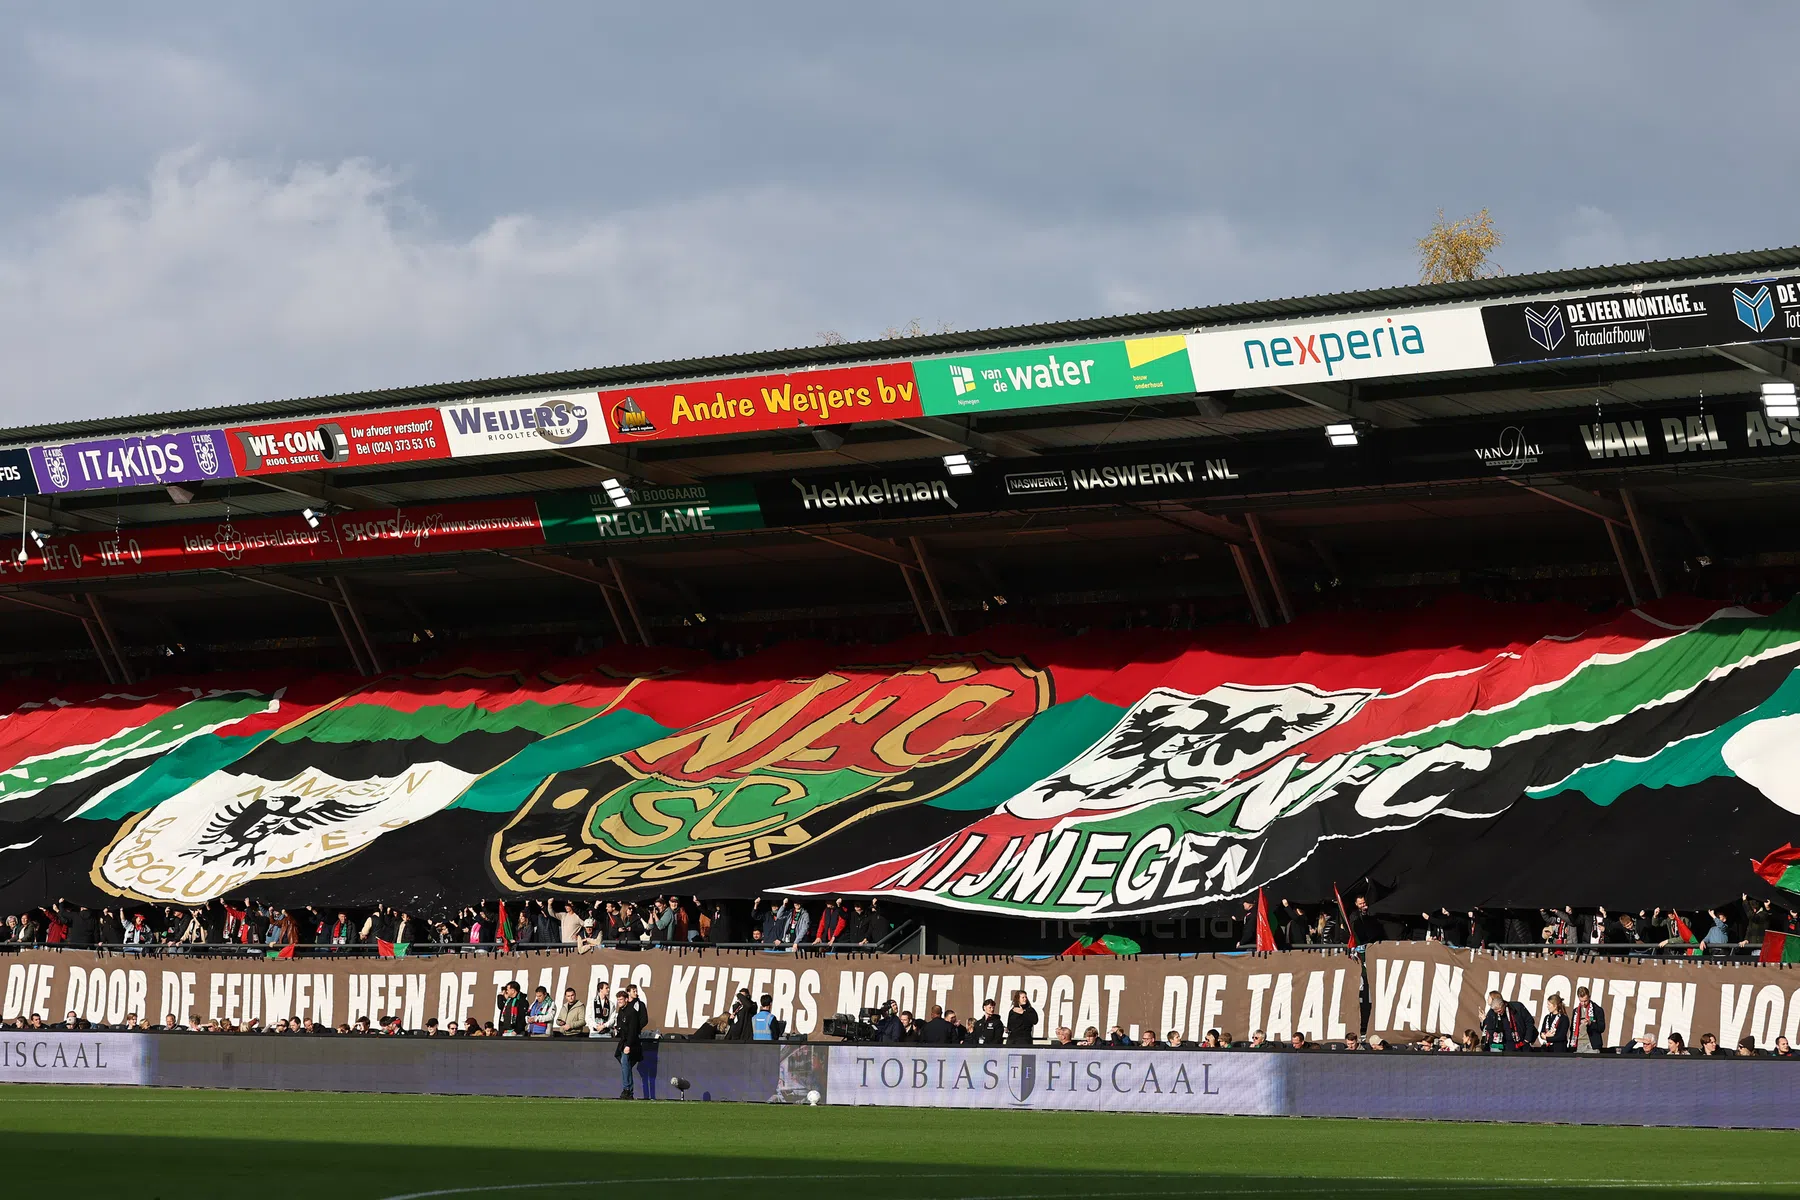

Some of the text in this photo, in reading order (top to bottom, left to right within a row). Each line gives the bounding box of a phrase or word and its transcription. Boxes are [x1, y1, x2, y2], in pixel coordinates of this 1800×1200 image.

[1566, 293, 1707, 323] DE VEER MONTAGE B.V.
[1776, 283, 1798, 304] DE
[1243, 317, 1426, 377] nexperia
[1573, 325, 1647, 348] Totaalafbouw
[980, 368, 1003, 381] van
[993, 354, 1095, 393] de water
[671, 376, 914, 426] Andre Weijers bv
[350, 419, 434, 439] Uw afvoer verstopt?
[449, 404, 571, 435] WEIJERS
[248, 430, 326, 457] WE-COM
[355, 436, 437, 455] Bel (024) 373 53 16
[488, 428, 572, 441] RIOOLTECHNIEK
[1580, 420, 1650, 459] VAN
[1661, 415, 1727, 453] DAL
[265, 454, 320, 467] RIOOL SERVICE
[642, 486, 707, 502] BOOGAARD
[797, 478, 952, 510] Hekkelman
[342, 518, 399, 542] SHOTS
[440, 516, 535, 533] WWW.SHOTSTOYS.NL
[595, 506, 716, 537] RECLAME
[98, 538, 142, 567] JEE-O
[243, 530, 333, 549] installateurs.
[597, 773, 807, 848] SC
[882, 824, 1270, 906] NIJMEGEN
[3, 963, 55, 1021] DIE
[64, 965, 148, 1026] DOOR
[159, 970, 198, 1026] DE
[209, 972, 335, 1030] EEUWEN
[346, 972, 427, 1031] HEEN
[437, 971, 478, 1031] DE
[664, 964, 821, 1035] KEIZERS
[836, 970, 955, 1022] NOOIT
[1160, 974, 1227, 1041] DIE
[1247, 968, 1346, 1042] TAAL
[1375, 958, 1463, 1036] VAN
[856, 1056, 1220, 1095] TOBIAS FISCAAL
